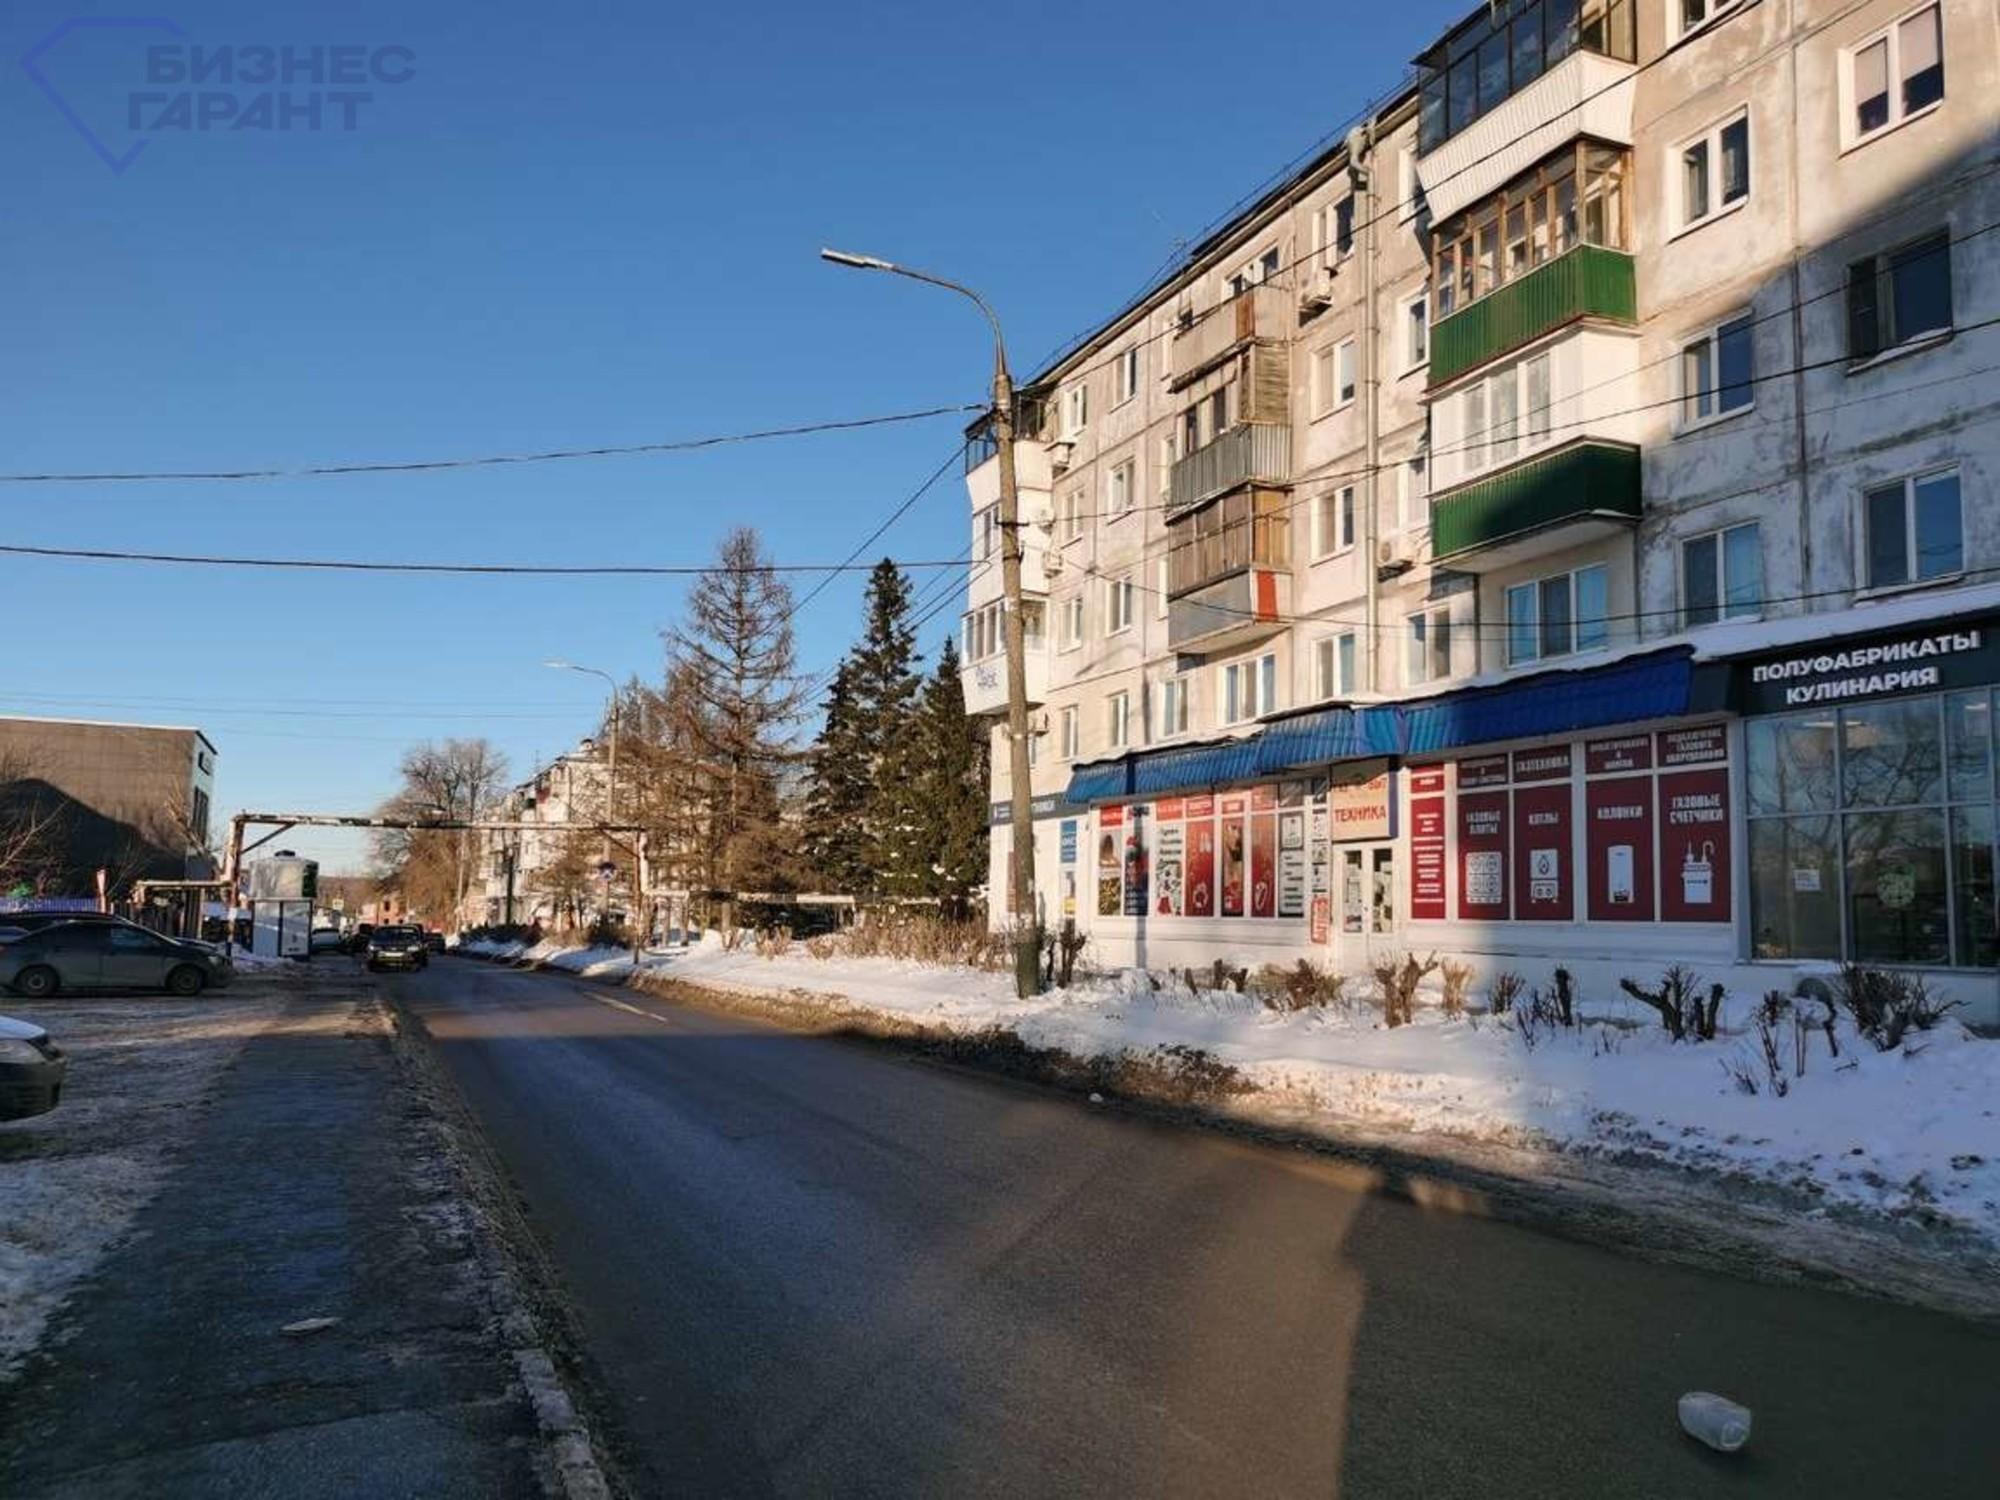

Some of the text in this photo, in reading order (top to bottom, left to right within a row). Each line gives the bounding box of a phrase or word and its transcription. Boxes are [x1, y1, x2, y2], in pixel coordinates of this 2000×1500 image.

[1753, 630, 1981, 682] ПОЛУФАБРИКАТЫ
[1786, 666, 1940, 704] КУЛИНАРИЯ
[1334, 805, 1386, 823] ТЕХНИКА
[1671, 793, 1720, 809] ГАЗОВЫЕ
